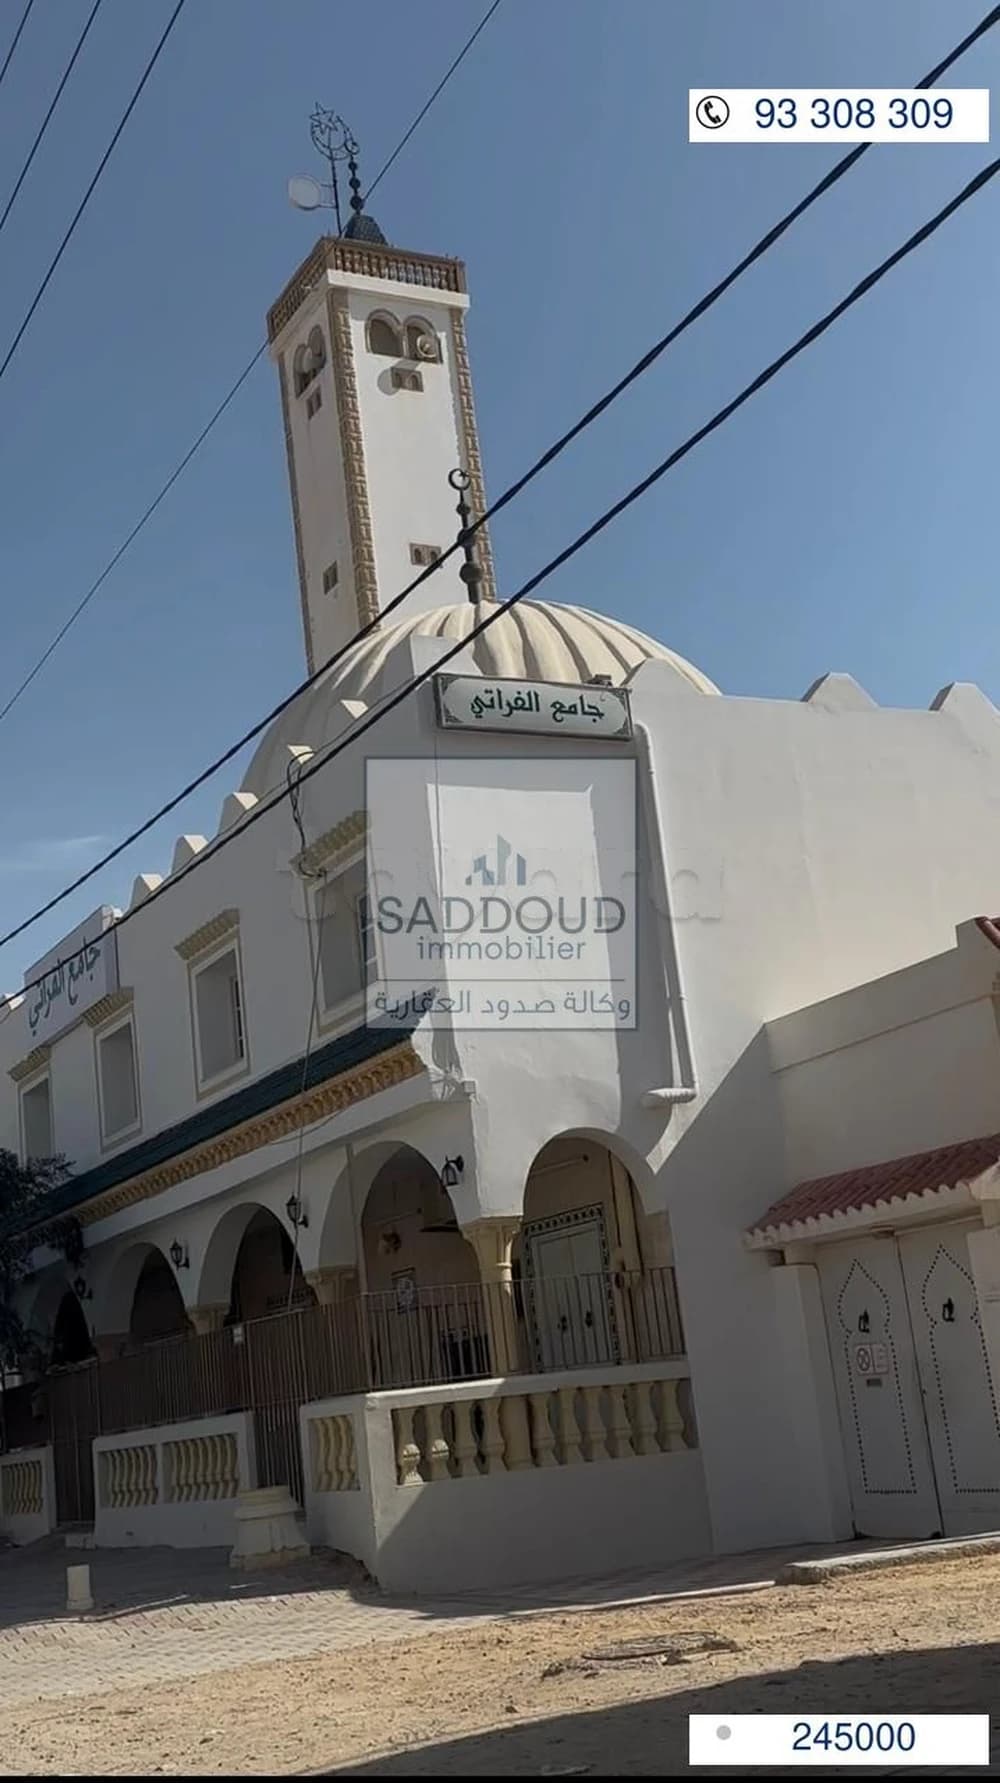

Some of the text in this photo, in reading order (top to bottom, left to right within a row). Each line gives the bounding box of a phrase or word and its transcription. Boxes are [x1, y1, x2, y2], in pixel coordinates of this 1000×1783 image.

[470, 688, 605, 723] جامع الفراتي
[67, 936, 101, 1006] جامع
